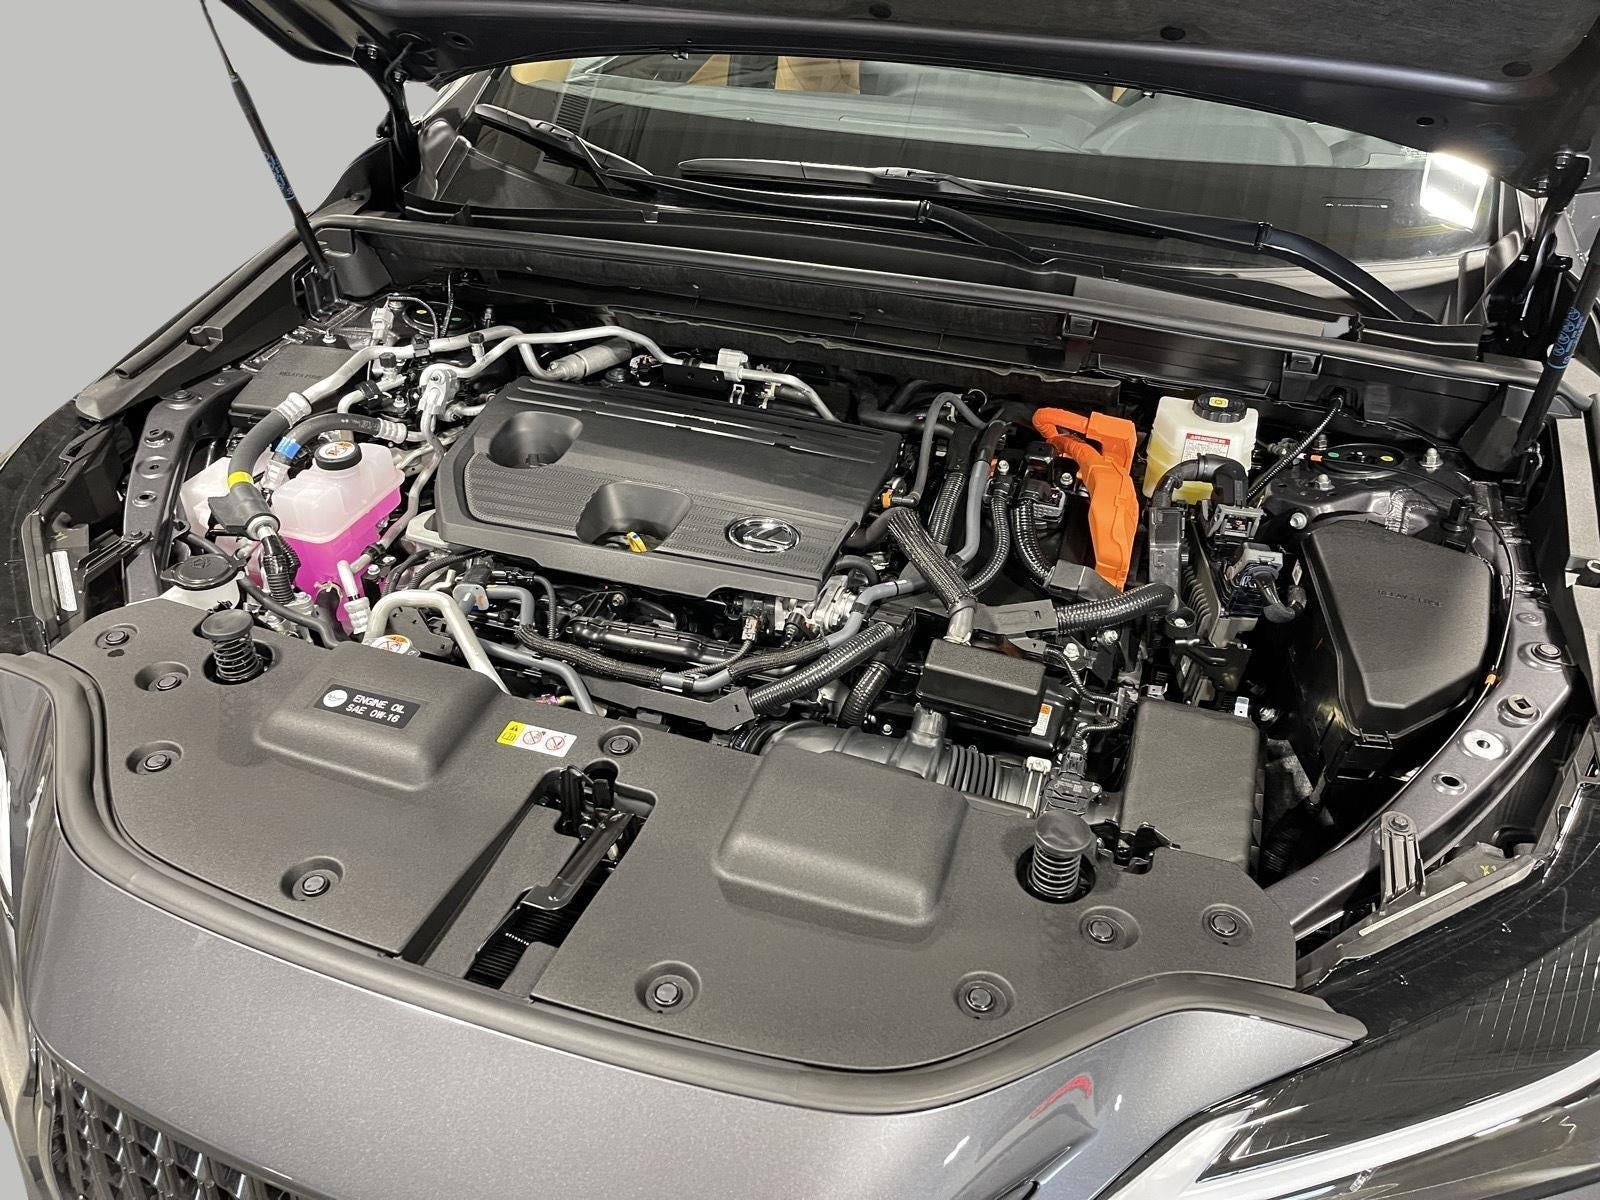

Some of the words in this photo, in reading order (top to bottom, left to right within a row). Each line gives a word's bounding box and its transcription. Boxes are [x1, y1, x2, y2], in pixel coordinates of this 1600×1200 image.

[346, 704, 368, 715] SAE
[370, 710, 400, 723] 0W-16
[353, 694, 388, 709] ENGINE
[391, 704, 406, 714] OIL
